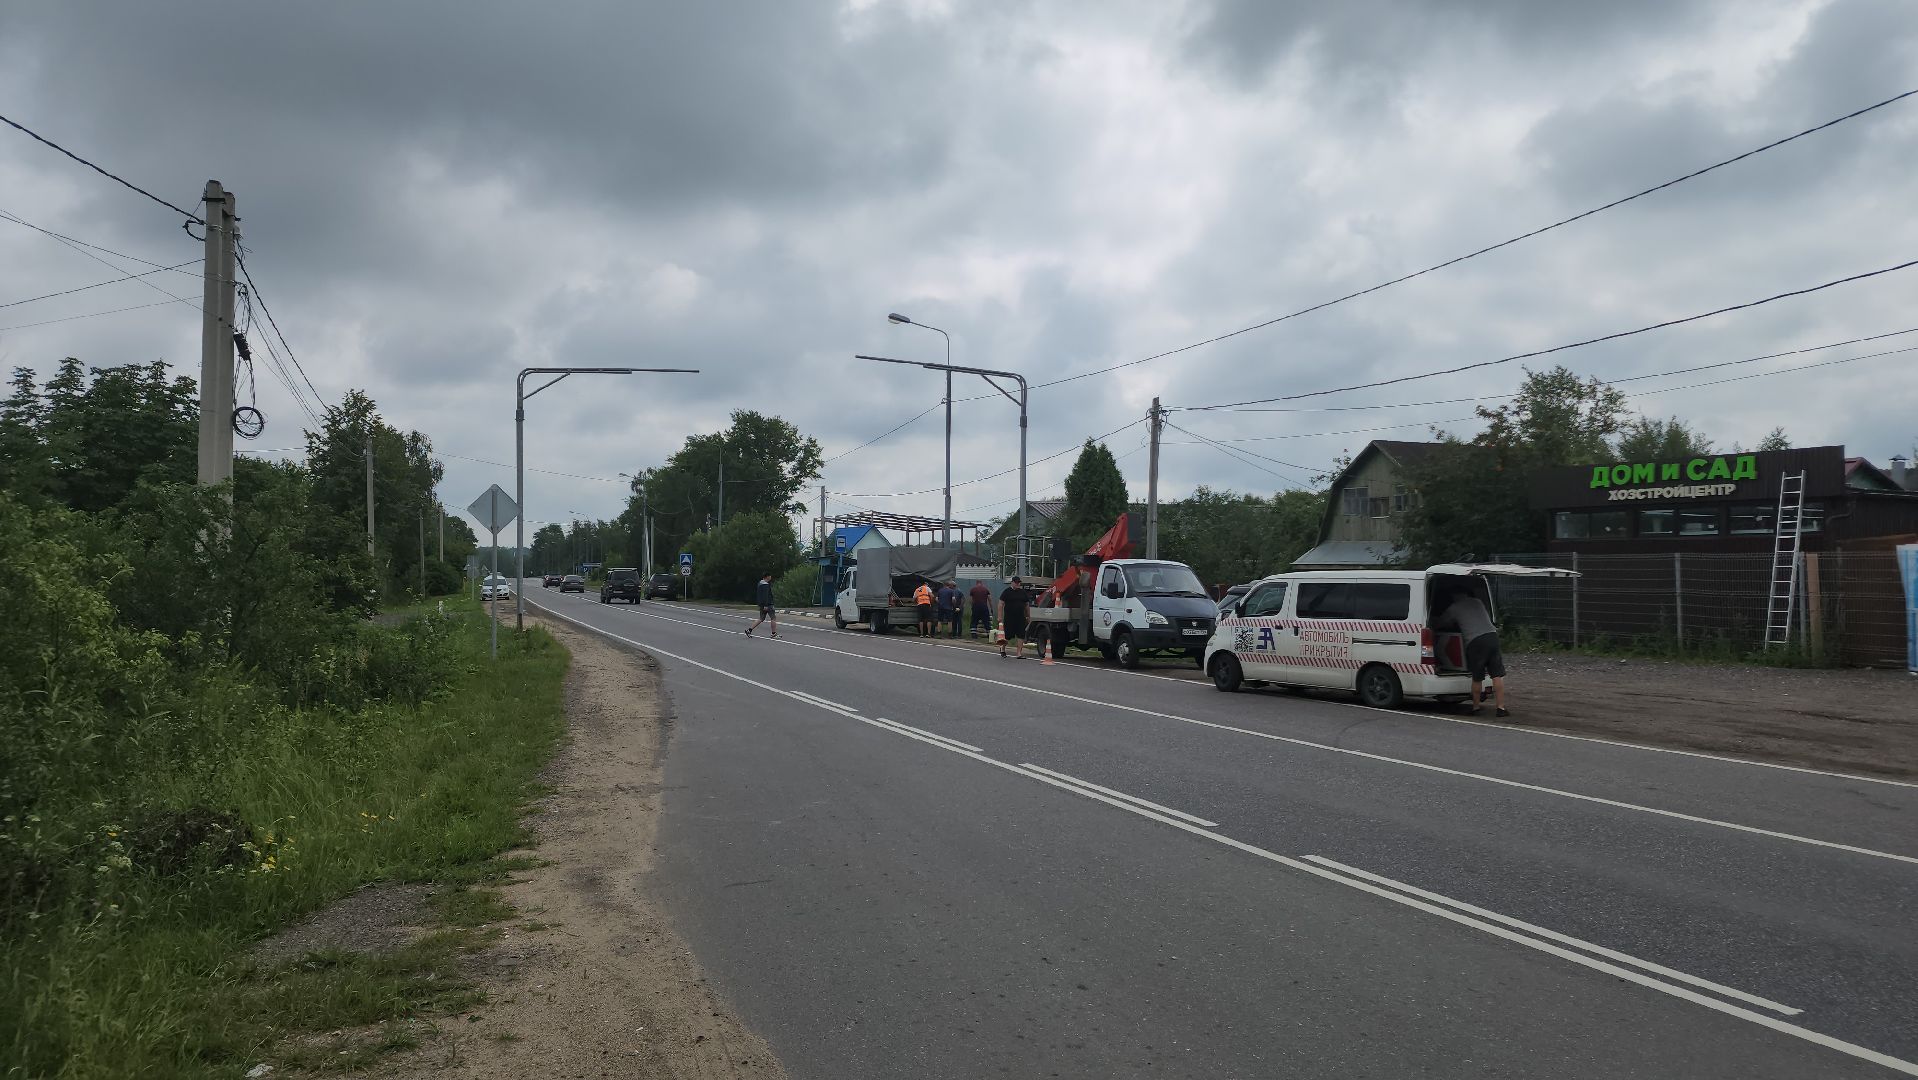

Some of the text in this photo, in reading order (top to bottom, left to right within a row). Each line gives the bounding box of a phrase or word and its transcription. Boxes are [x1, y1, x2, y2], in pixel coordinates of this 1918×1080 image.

[1590, 463, 1655, 488] ДОМ
[1686, 455, 1758, 481] САД
[1608, 483, 1736, 501] ХОЗСТРОЙЦЕНТР
